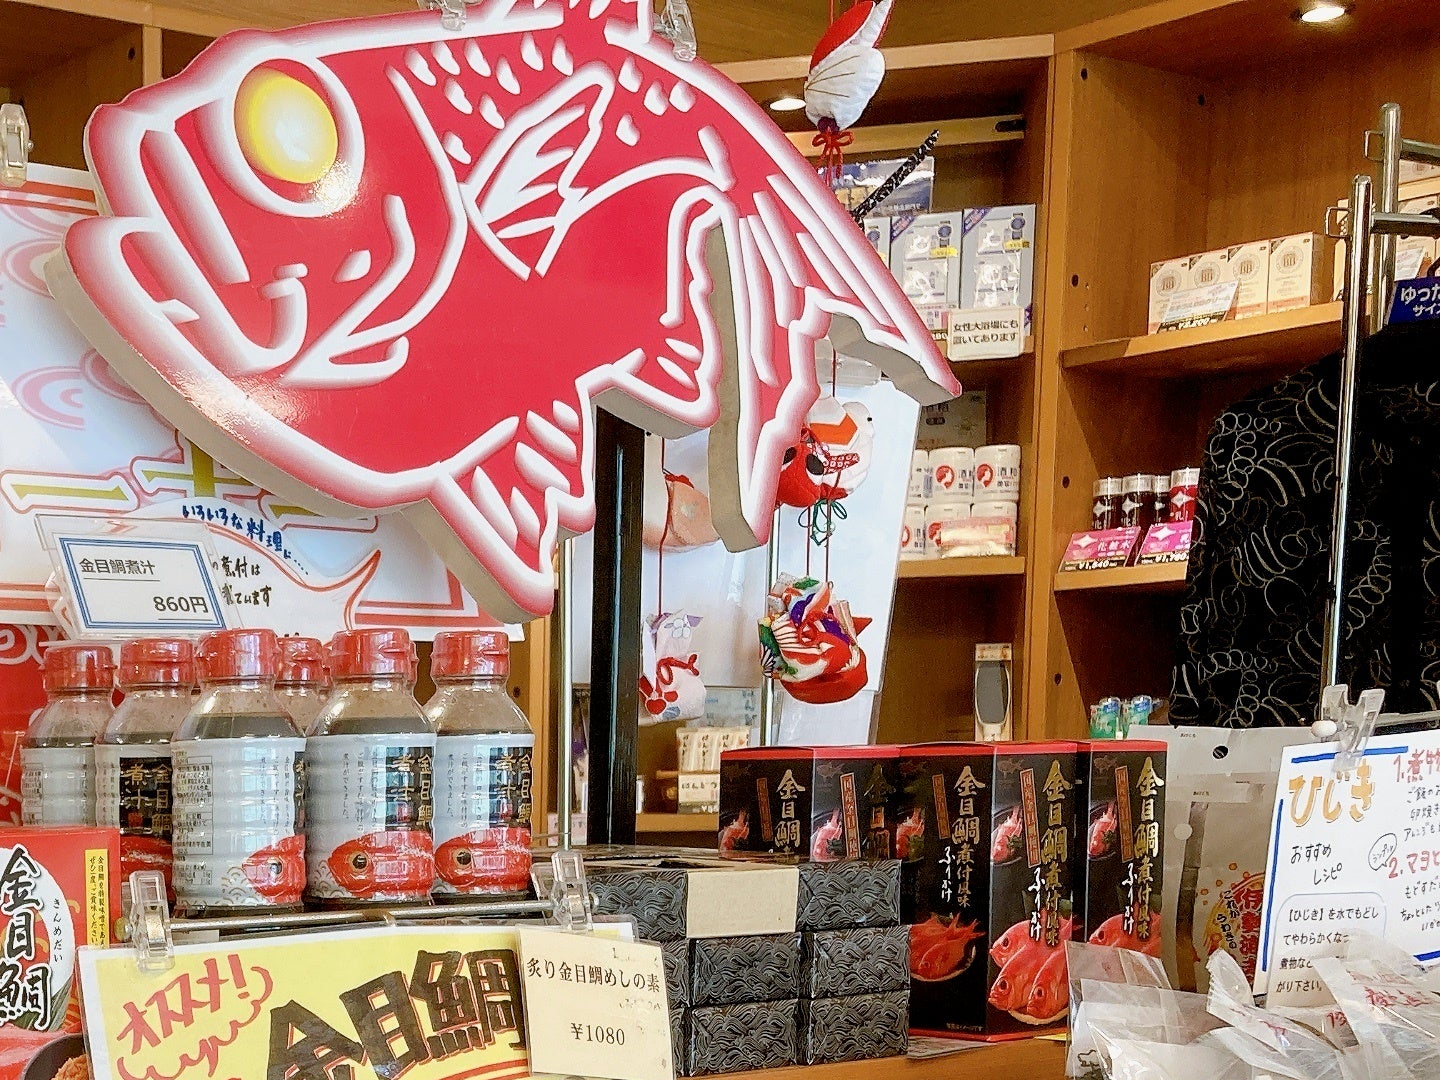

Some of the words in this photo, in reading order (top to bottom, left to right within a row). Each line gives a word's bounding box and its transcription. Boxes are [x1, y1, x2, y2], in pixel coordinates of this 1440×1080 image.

[952, 319, 1020, 333] 女性大浴場にも
[952, 332, 1020, 345] 置いてあります
[78, 557, 157, 577] 金目鯛煮汁
[153, 595, 210, 614] 860円
[122, 764, 151, 810] 煮汁
[1288, 758, 1376, 828] ひじき
[951, 765, 986, 908] 金目鯛煮付風味
[1040, 759, 1073, 947] 金目鯛煮付風味
[1133, 756, 1166, 940] 金目鯛煮付風味
[1290, 843, 1333, 865] おすすめ
[938, 846, 956, 903] ふりかけ
[1313, 862, 1344, 886] レシピ
[1027, 867, 1046, 942] ふりかけ
[1121, 862, 1138, 935] ふりかけ
[1288, 906, 1380, 921] 【ひじき】を水でもどし
[53, 898, 63, 963] きんめだい
[526, 957, 661, 993] 炙り金目鯛めしの素
[570, 1022, 625, 1046] ¥1080
